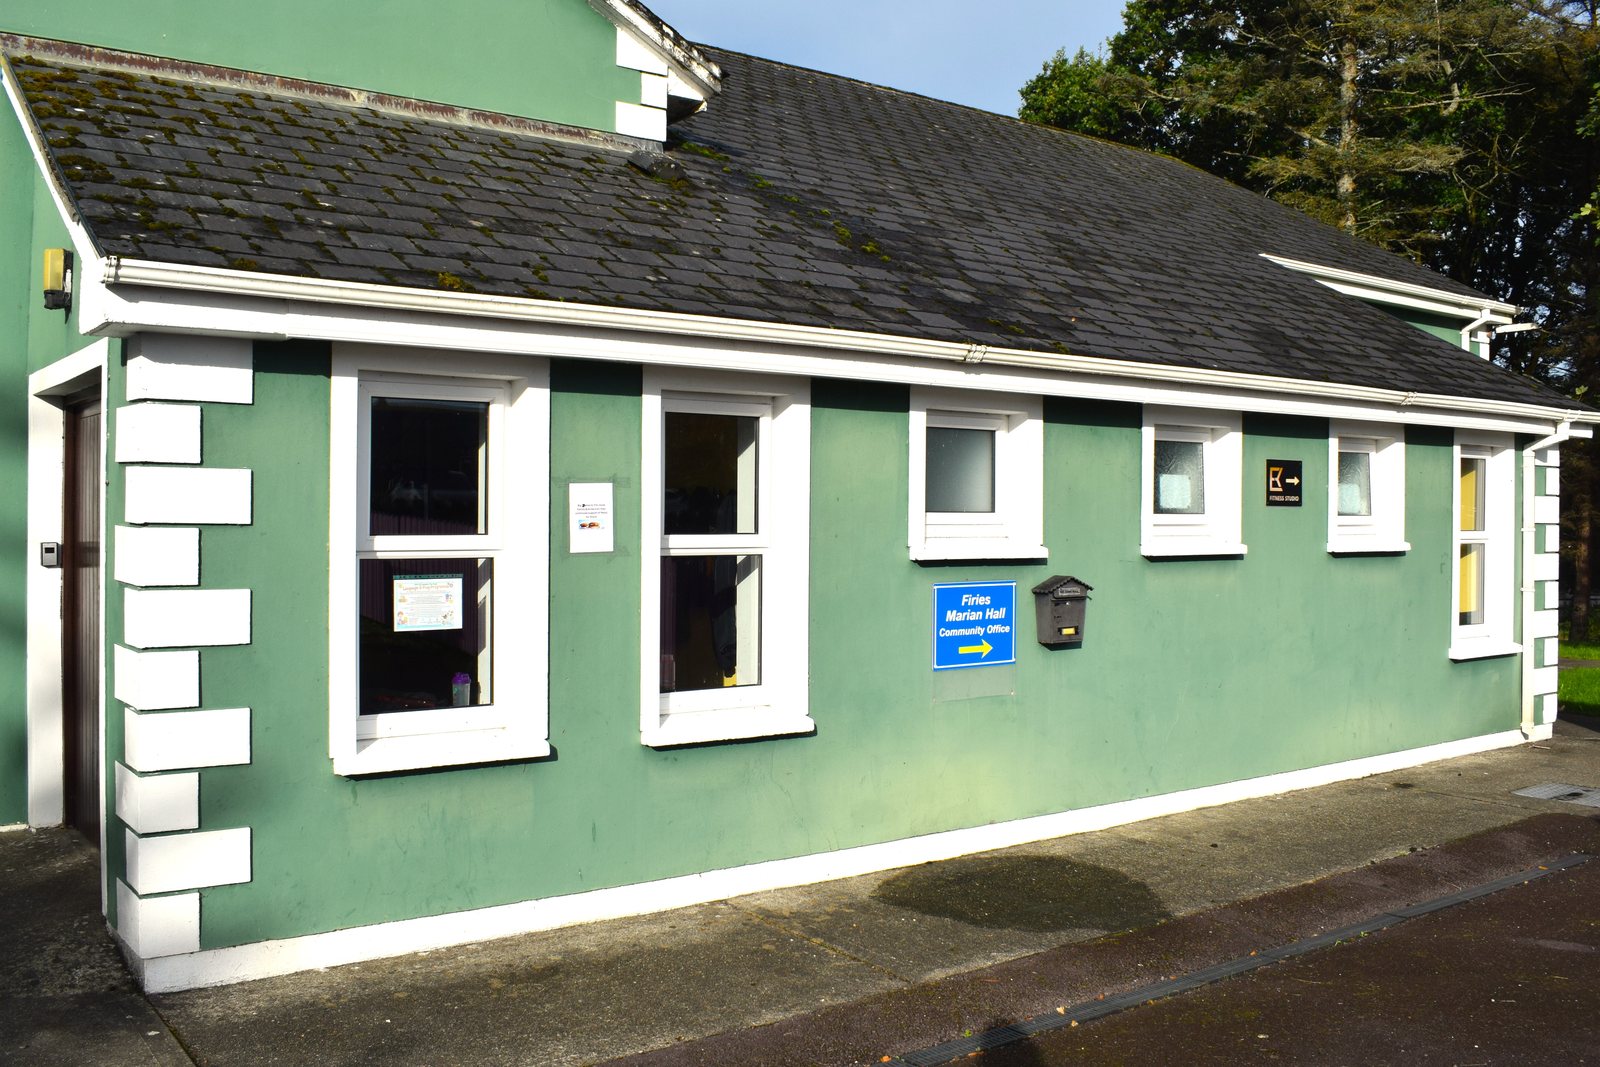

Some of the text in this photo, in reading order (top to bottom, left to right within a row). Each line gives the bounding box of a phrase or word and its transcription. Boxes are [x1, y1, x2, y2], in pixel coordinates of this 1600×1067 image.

[961, 594, 991, 606] Firies
[945, 607, 1006, 622] Marian Hall
[939, 624, 1010, 637] Community Office
